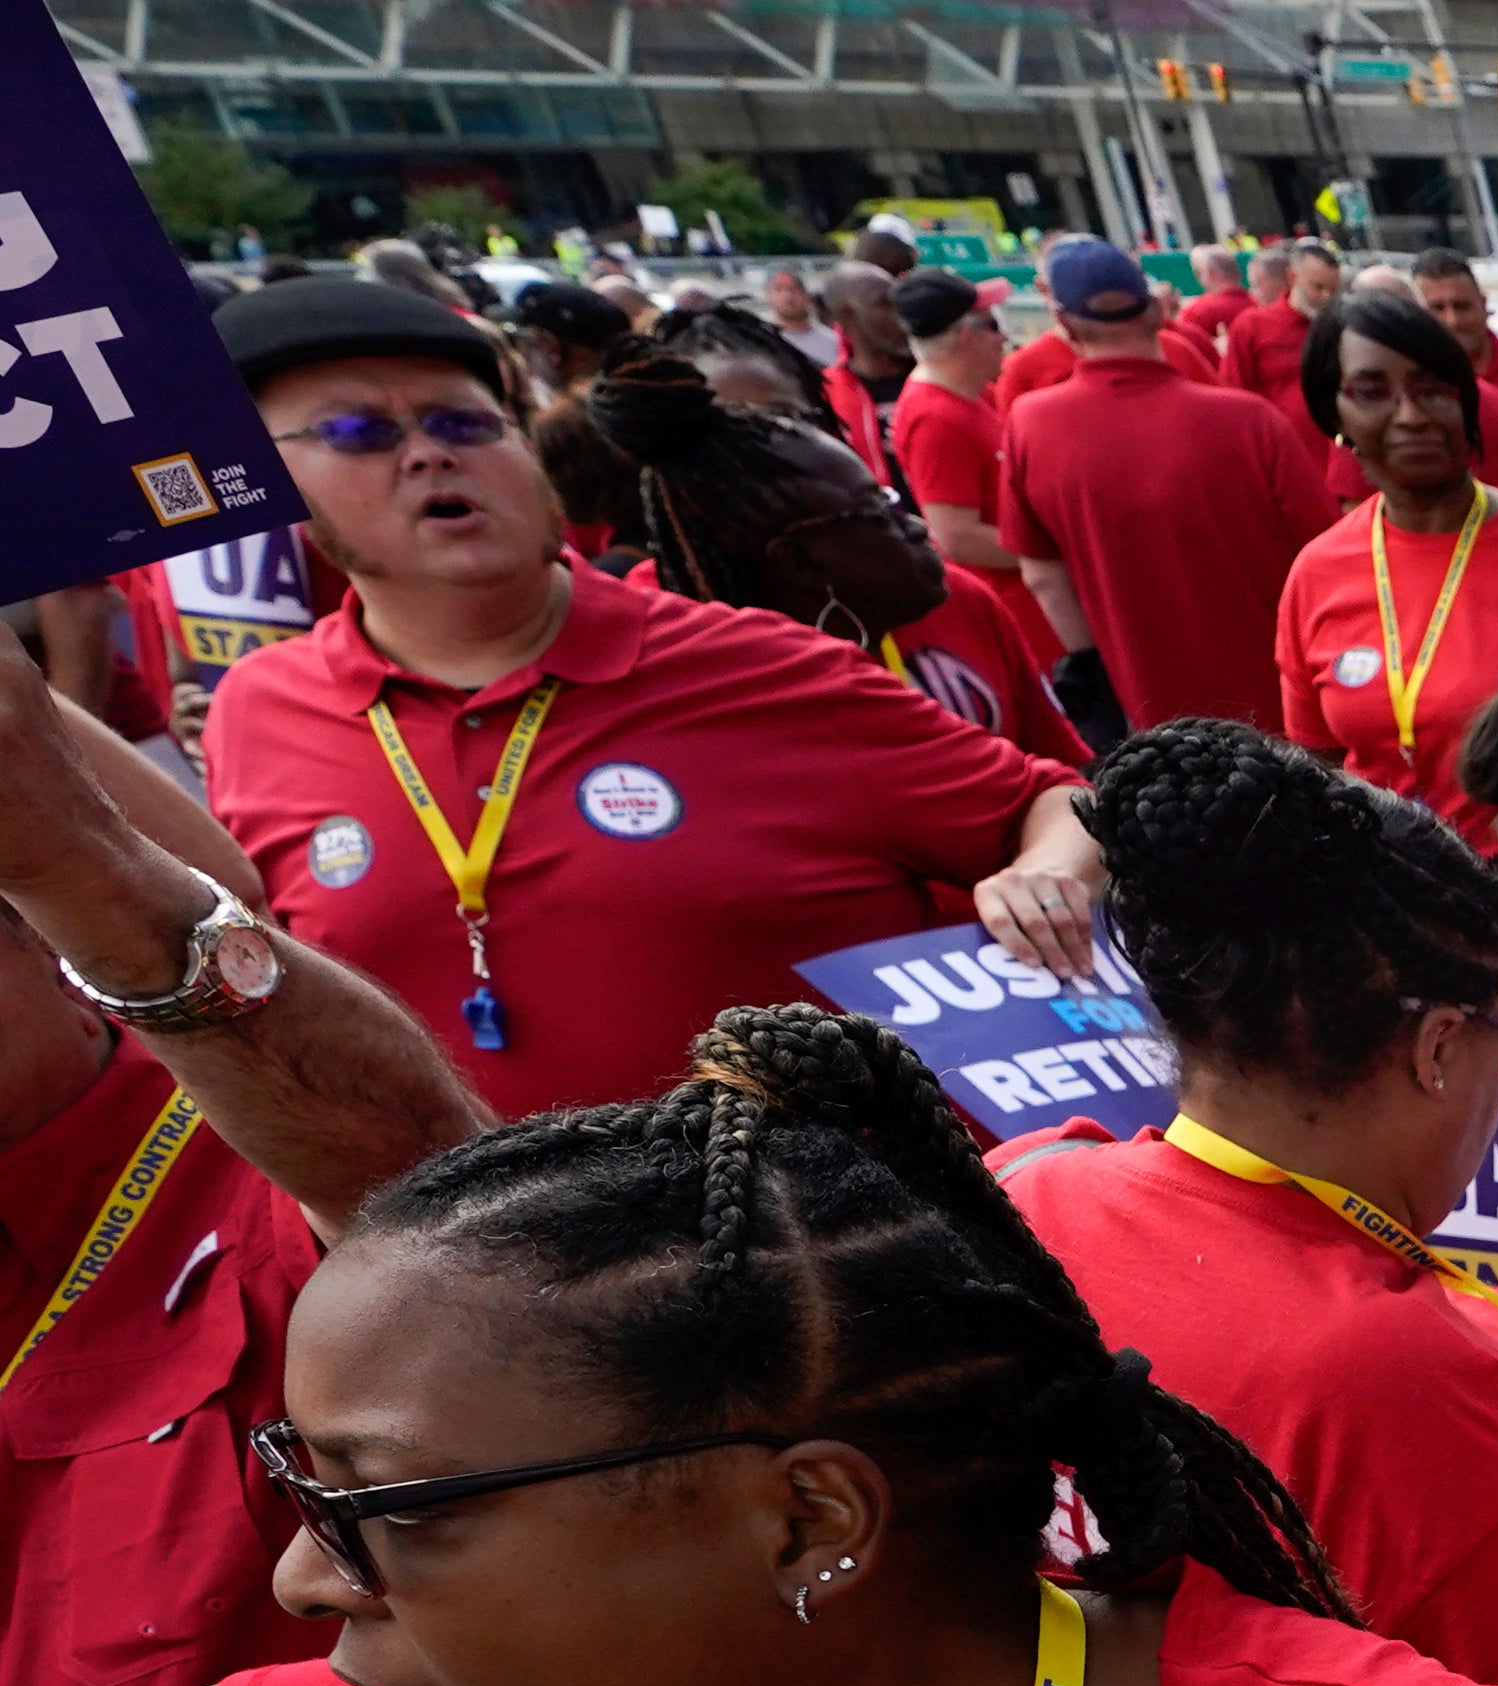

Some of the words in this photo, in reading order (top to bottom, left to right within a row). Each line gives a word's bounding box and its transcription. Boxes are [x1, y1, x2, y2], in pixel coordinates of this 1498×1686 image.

[212, 464, 246, 484] JOIN
[215, 479, 248, 495] THE
[222, 488, 267, 511] FIGHT
[1049, 998, 1147, 1035] FOR
[1341, 1196, 1438, 1268] FIGHTIN
[62, 1203, 135, 1302] STRONG
